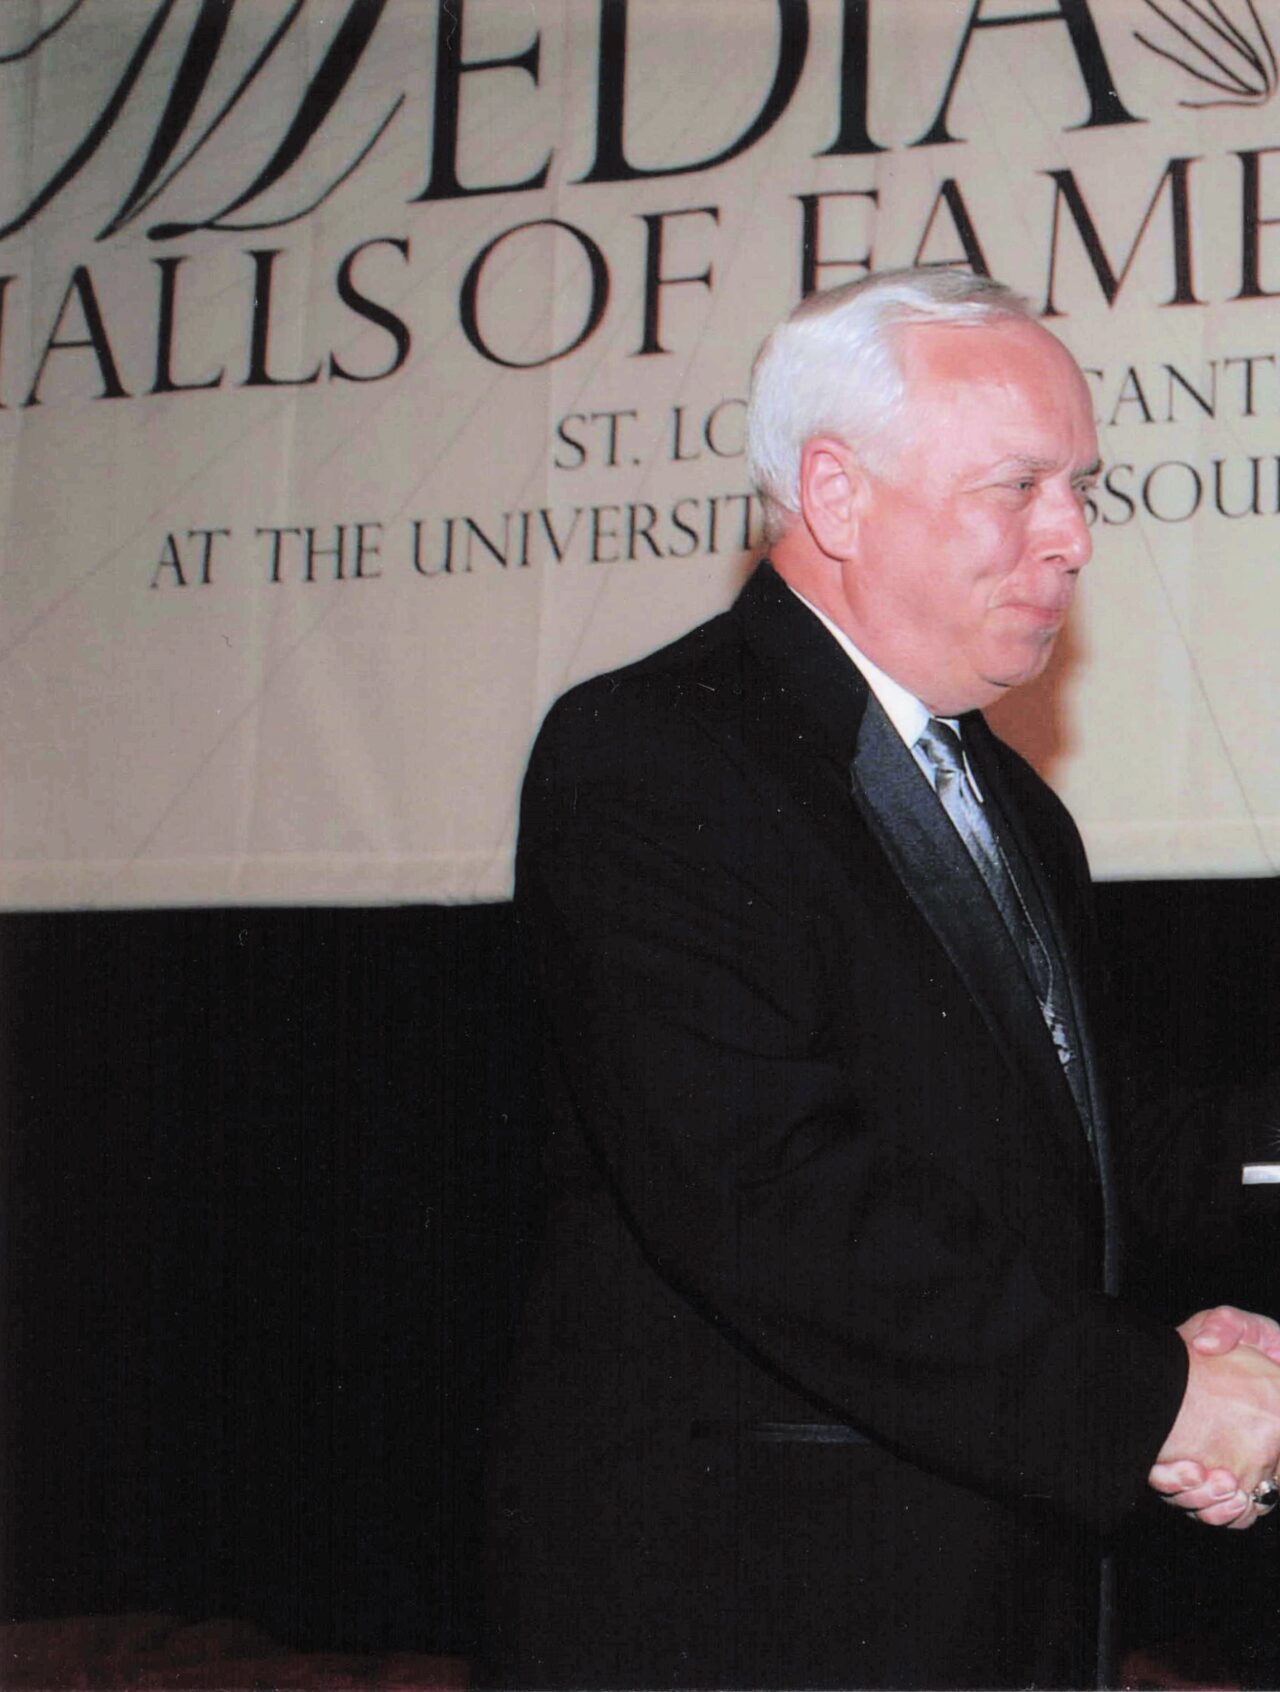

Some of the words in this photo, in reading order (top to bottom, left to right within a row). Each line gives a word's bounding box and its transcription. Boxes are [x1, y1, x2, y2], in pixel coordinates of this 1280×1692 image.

[0, 238, 412, 409] ALLS
[459, 206, 722, 369] OF
[553, 409, 642, 471] ST.
[150, 529, 231, 590] AT
[255, 522, 383, 584] THE
[410, 493, 757, 577] UNIVERSIT
